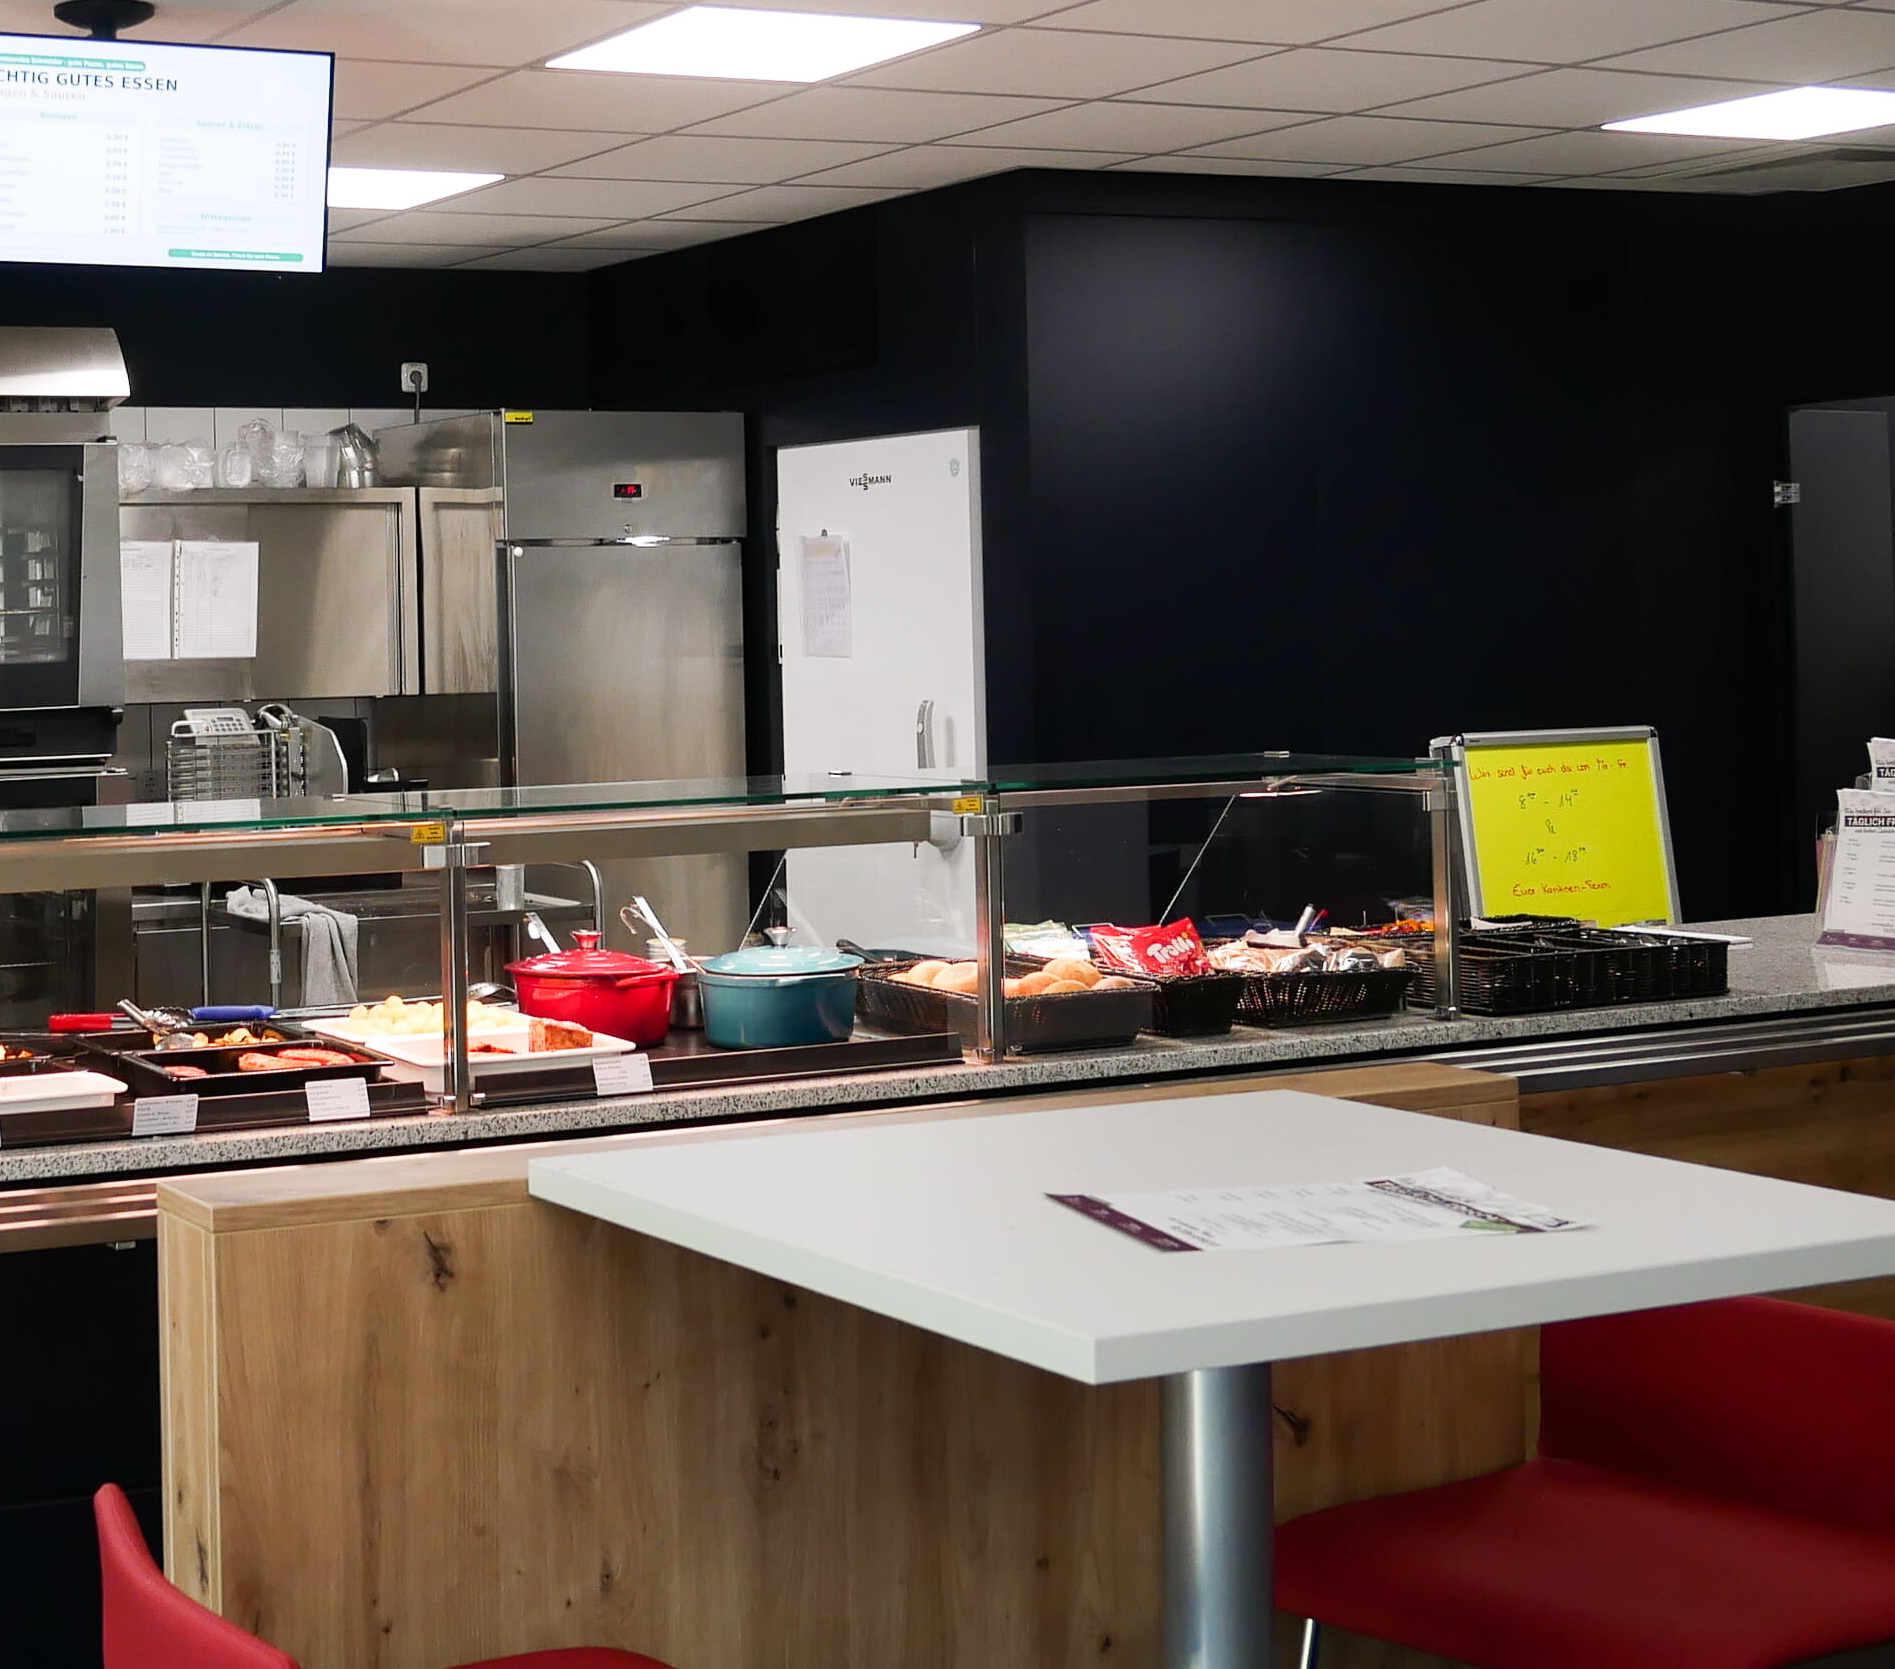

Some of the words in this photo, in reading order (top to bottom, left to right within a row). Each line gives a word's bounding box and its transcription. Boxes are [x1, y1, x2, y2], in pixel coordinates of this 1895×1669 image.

[56, 72, 114, 88] GUTES
[122, 76, 178, 92] ESSEN
[31, 87, 40, 98] &
[43, 88, 86, 101] Saucen
[849, 473, 892, 491] VIESSMANN
[1468, 766, 1491, 781] Wir
[1497, 766, 1517, 779] sind
[1146, 931, 1196, 964] Trolli
